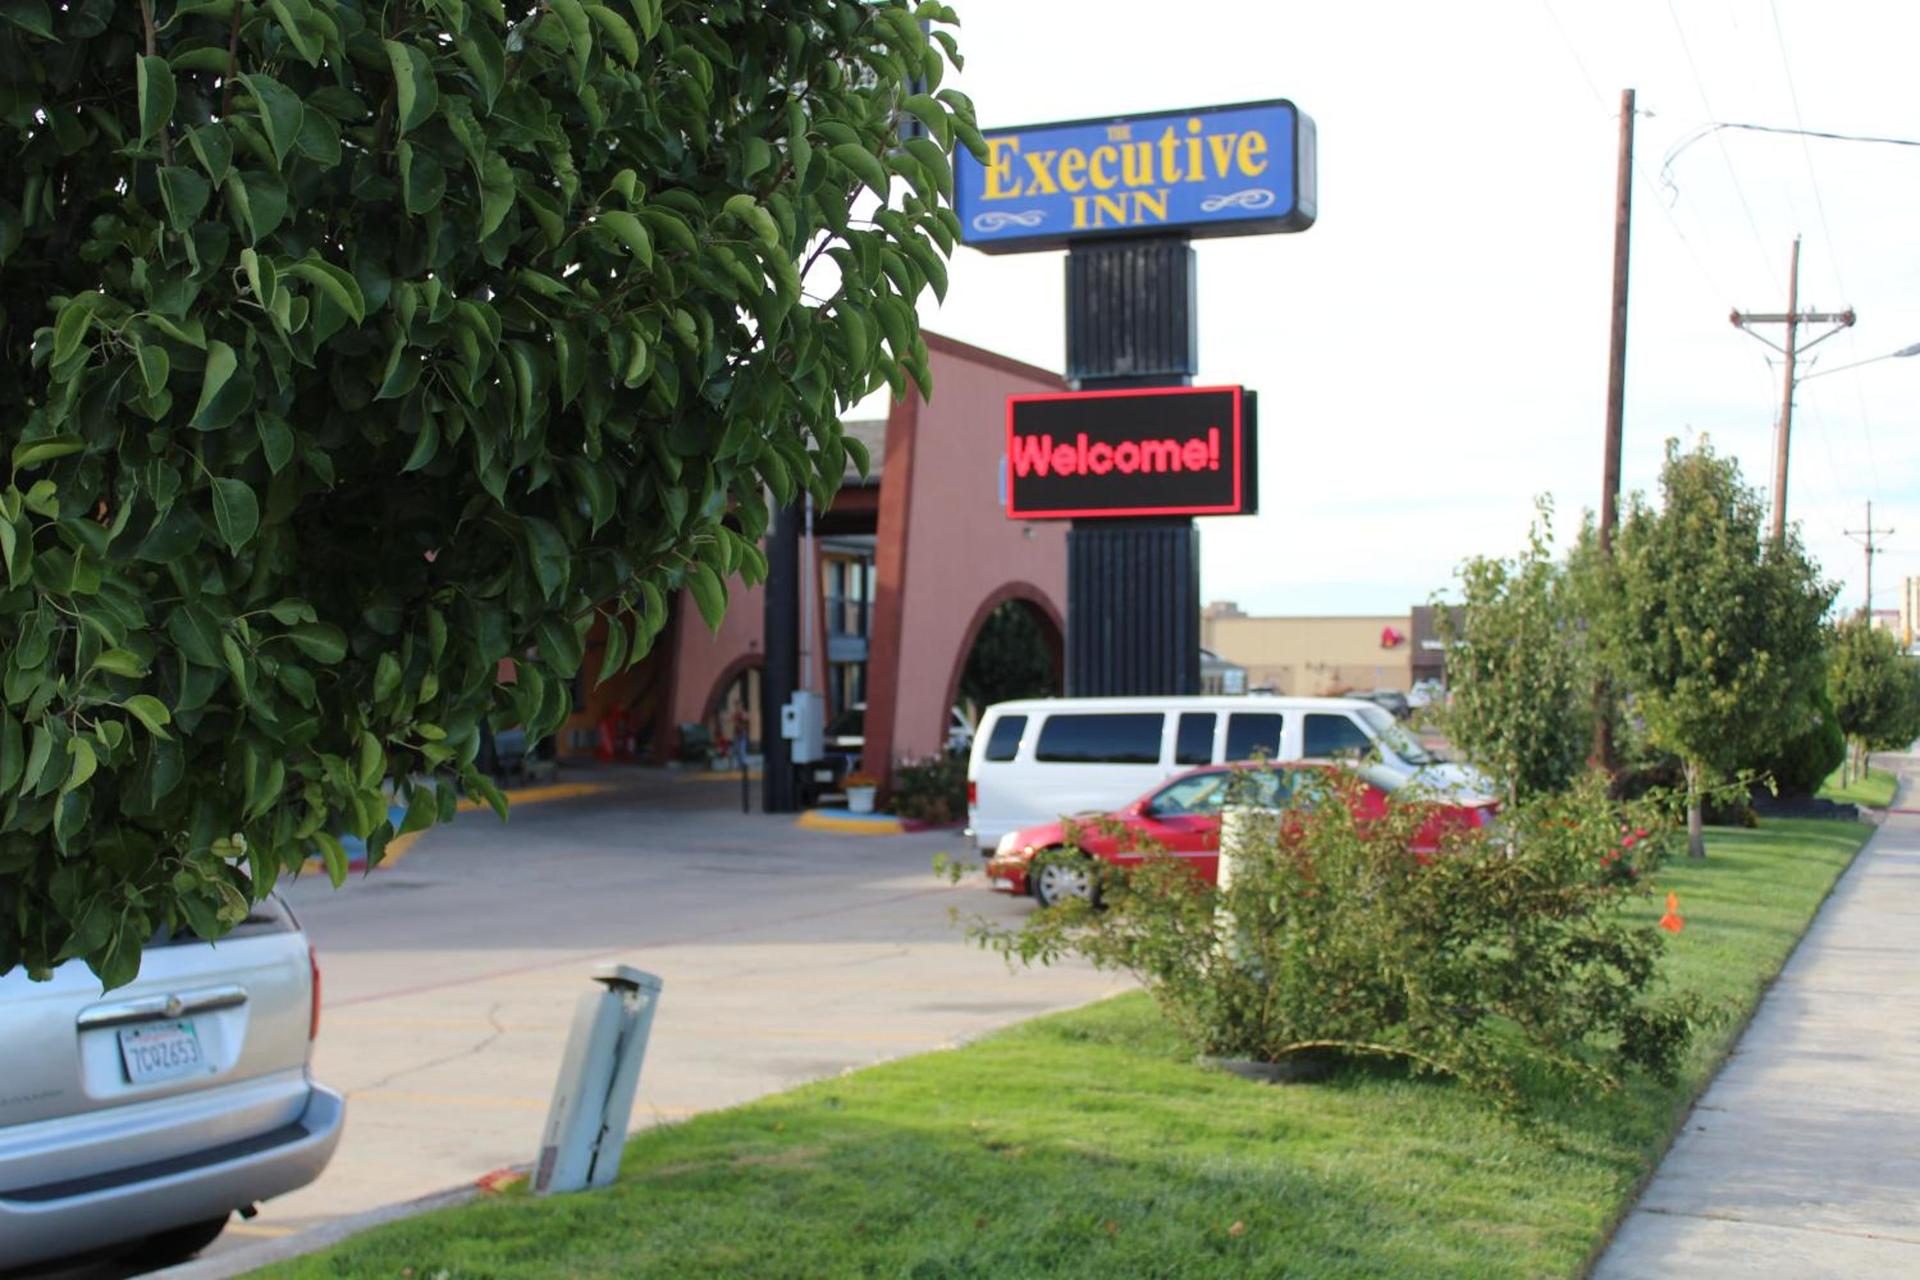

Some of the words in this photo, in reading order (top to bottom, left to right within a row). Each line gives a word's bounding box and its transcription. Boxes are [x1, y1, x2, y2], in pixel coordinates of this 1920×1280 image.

[981, 118, 1268, 200] Executive
[1071, 189, 1170, 229] INN
[1013, 427, 1220, 477] Welcome!
